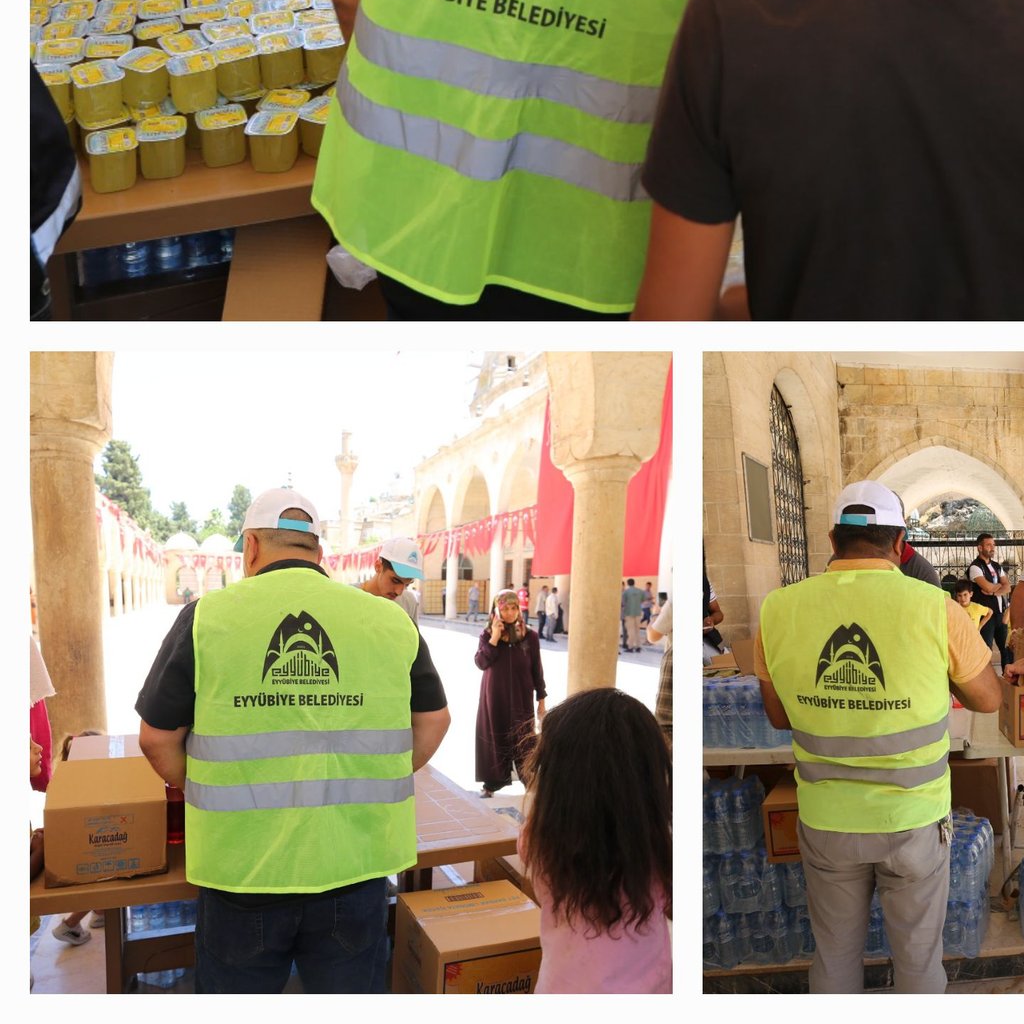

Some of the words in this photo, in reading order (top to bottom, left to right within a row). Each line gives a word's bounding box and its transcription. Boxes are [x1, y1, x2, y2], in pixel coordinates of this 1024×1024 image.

[233, 691, 296, 707] EYYÜBİYE
[298, 692, 364, 706] BELEDİYESİ
[797, 695, 845, 709] EYYÜBİYE
[847, 697, 911, 711] BELEDİYESİ
